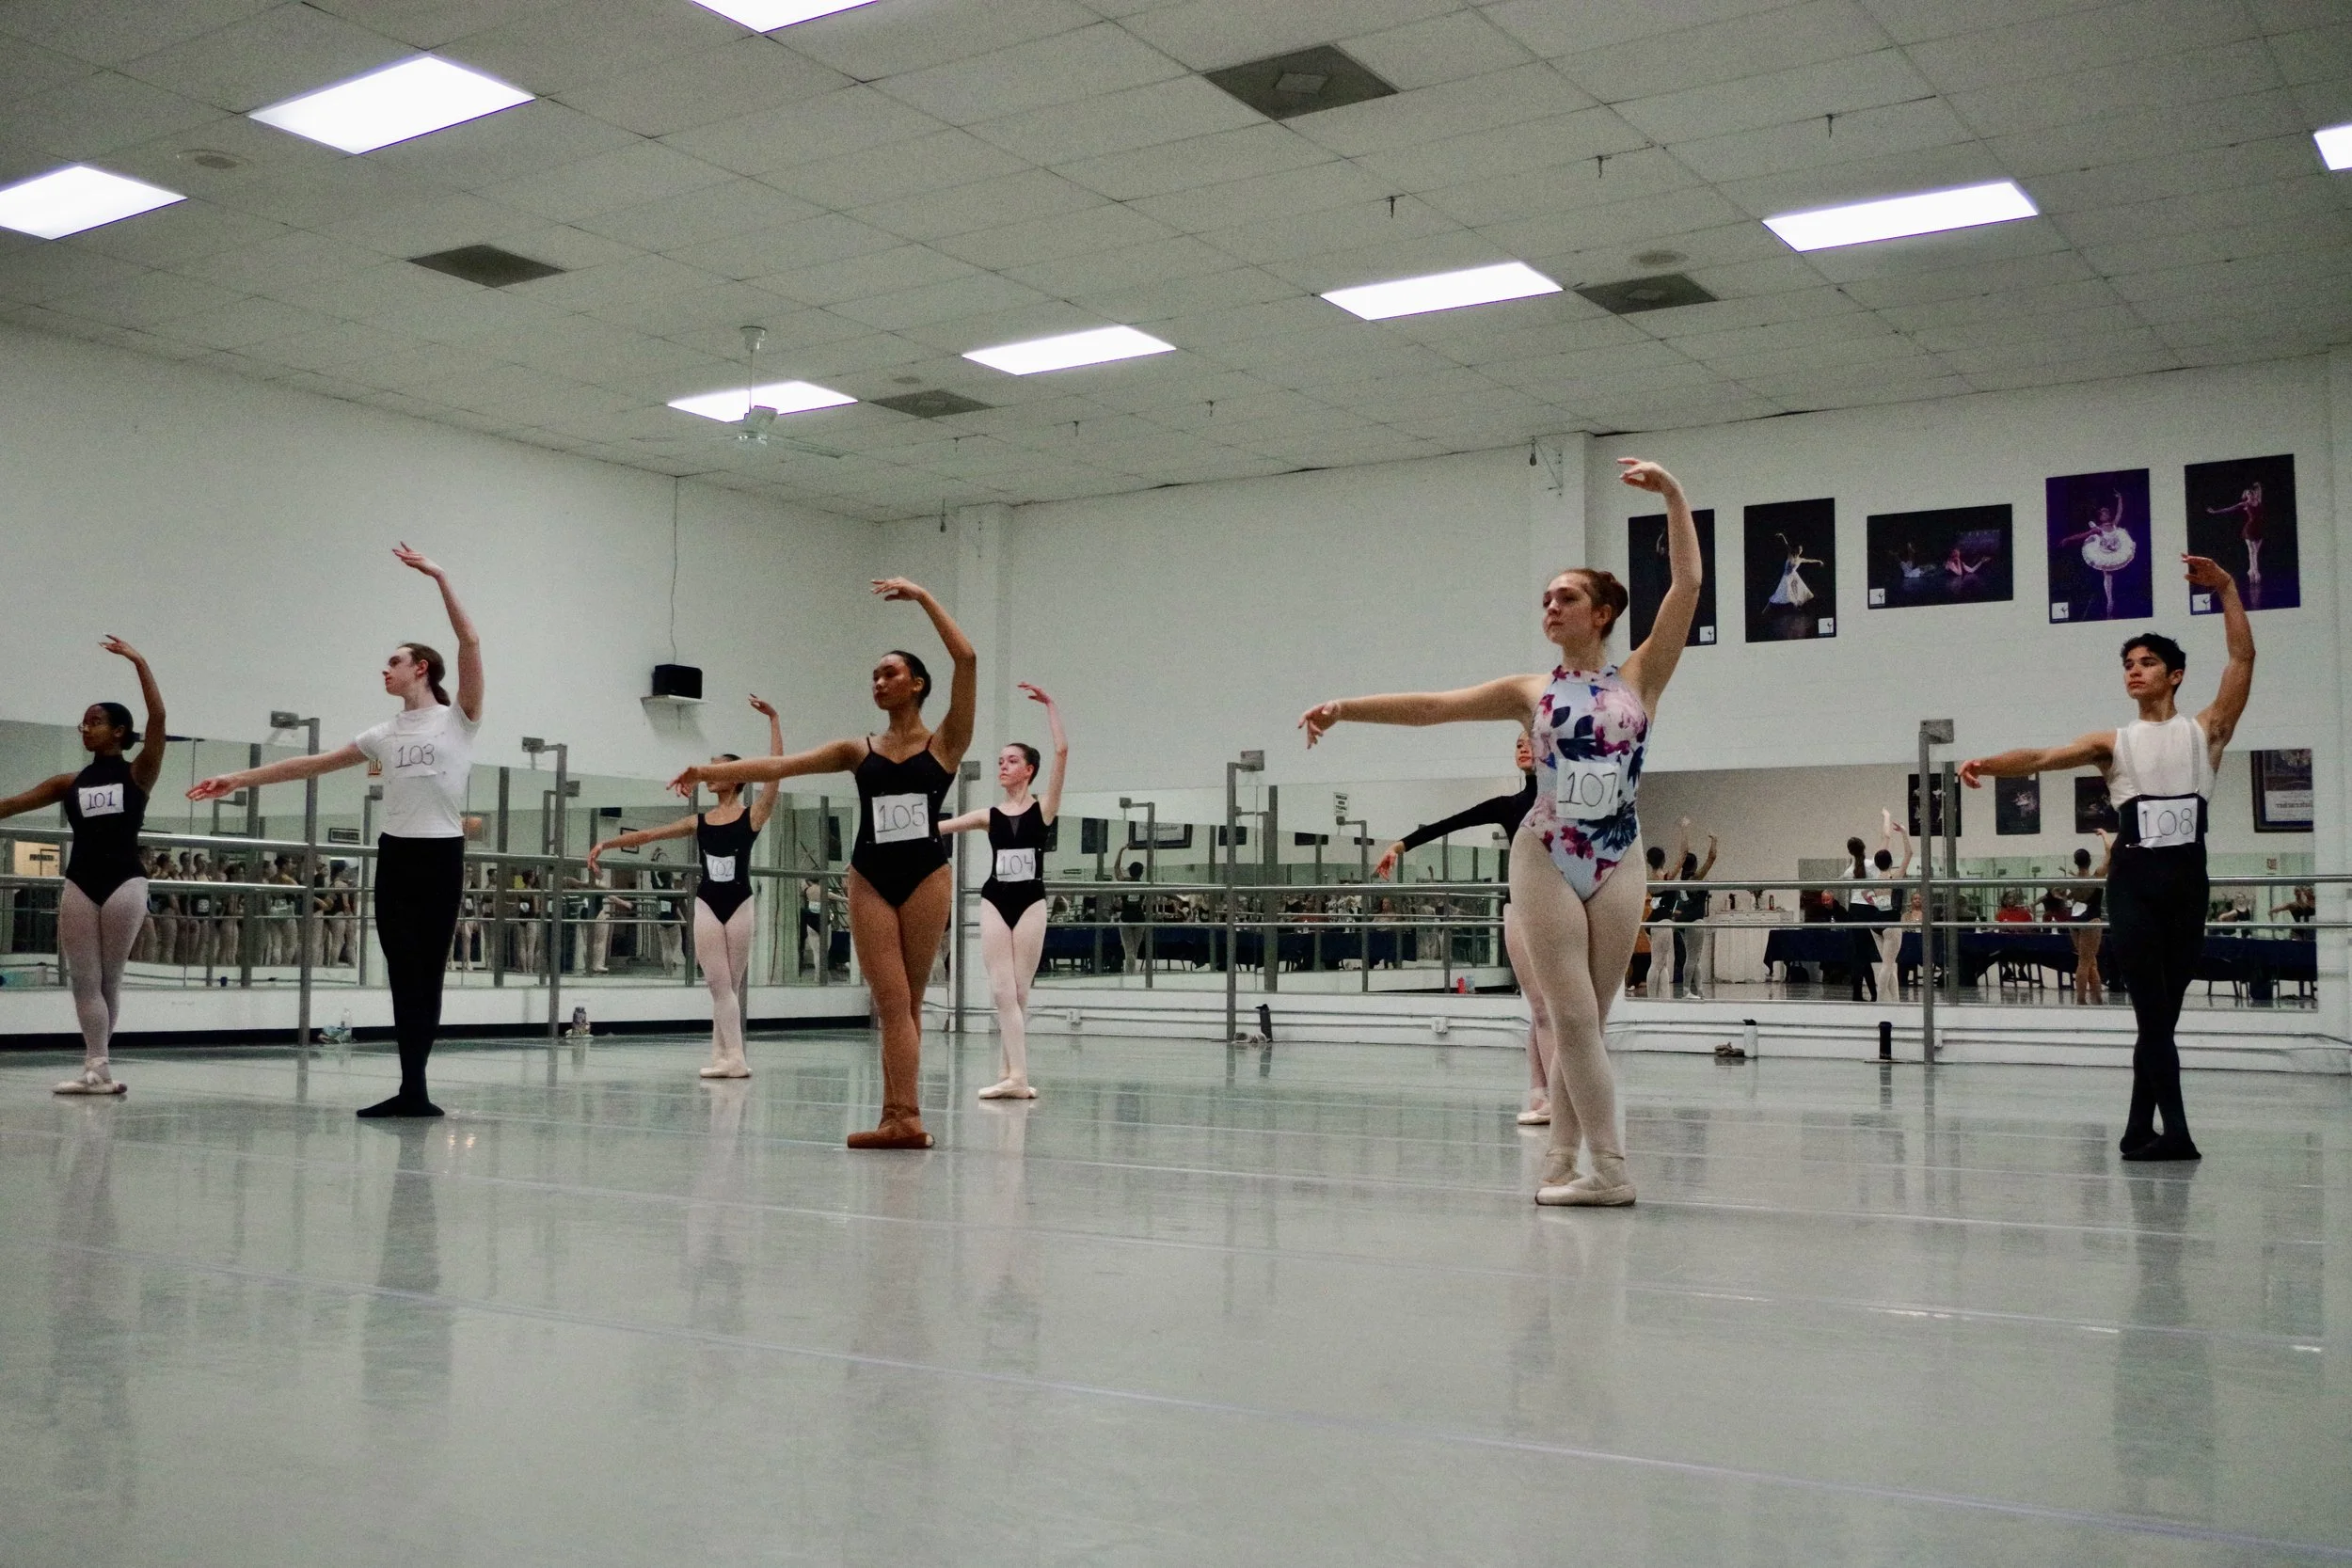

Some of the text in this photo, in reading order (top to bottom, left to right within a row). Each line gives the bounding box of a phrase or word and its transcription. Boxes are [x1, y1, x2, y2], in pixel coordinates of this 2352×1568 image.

[395, 743, 435, 768] 103
[86, 791, 117, 811] 101
[1558, 771, 1617, 807] 107
[876, 802, 926, 833] 105
[2141, 807, 2194, 840] 108
[711, 859, 733, 878] 102
[997, 854, 1034, 876] 104
